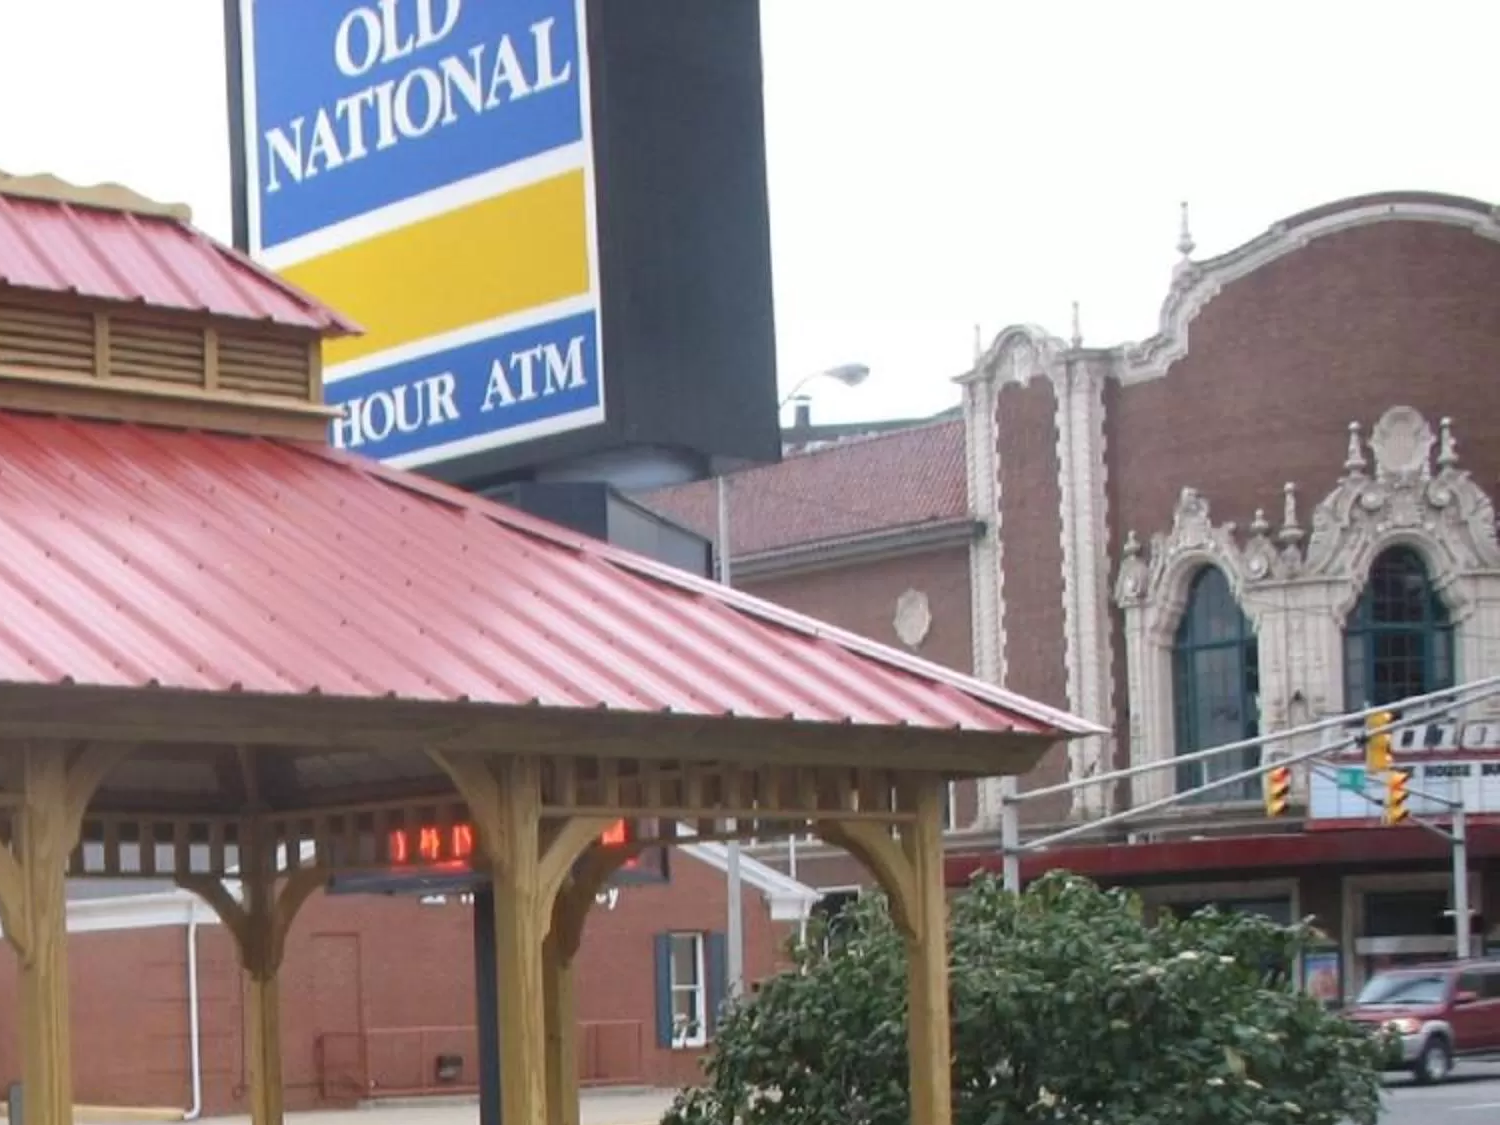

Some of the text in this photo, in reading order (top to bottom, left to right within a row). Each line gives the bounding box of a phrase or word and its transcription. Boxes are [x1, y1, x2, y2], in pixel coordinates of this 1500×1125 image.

[335, 0, 461, 77] OLD
[264, 16, 571, 192] NATIONAL
[330, 336, 587, 448] HOUR ATM
